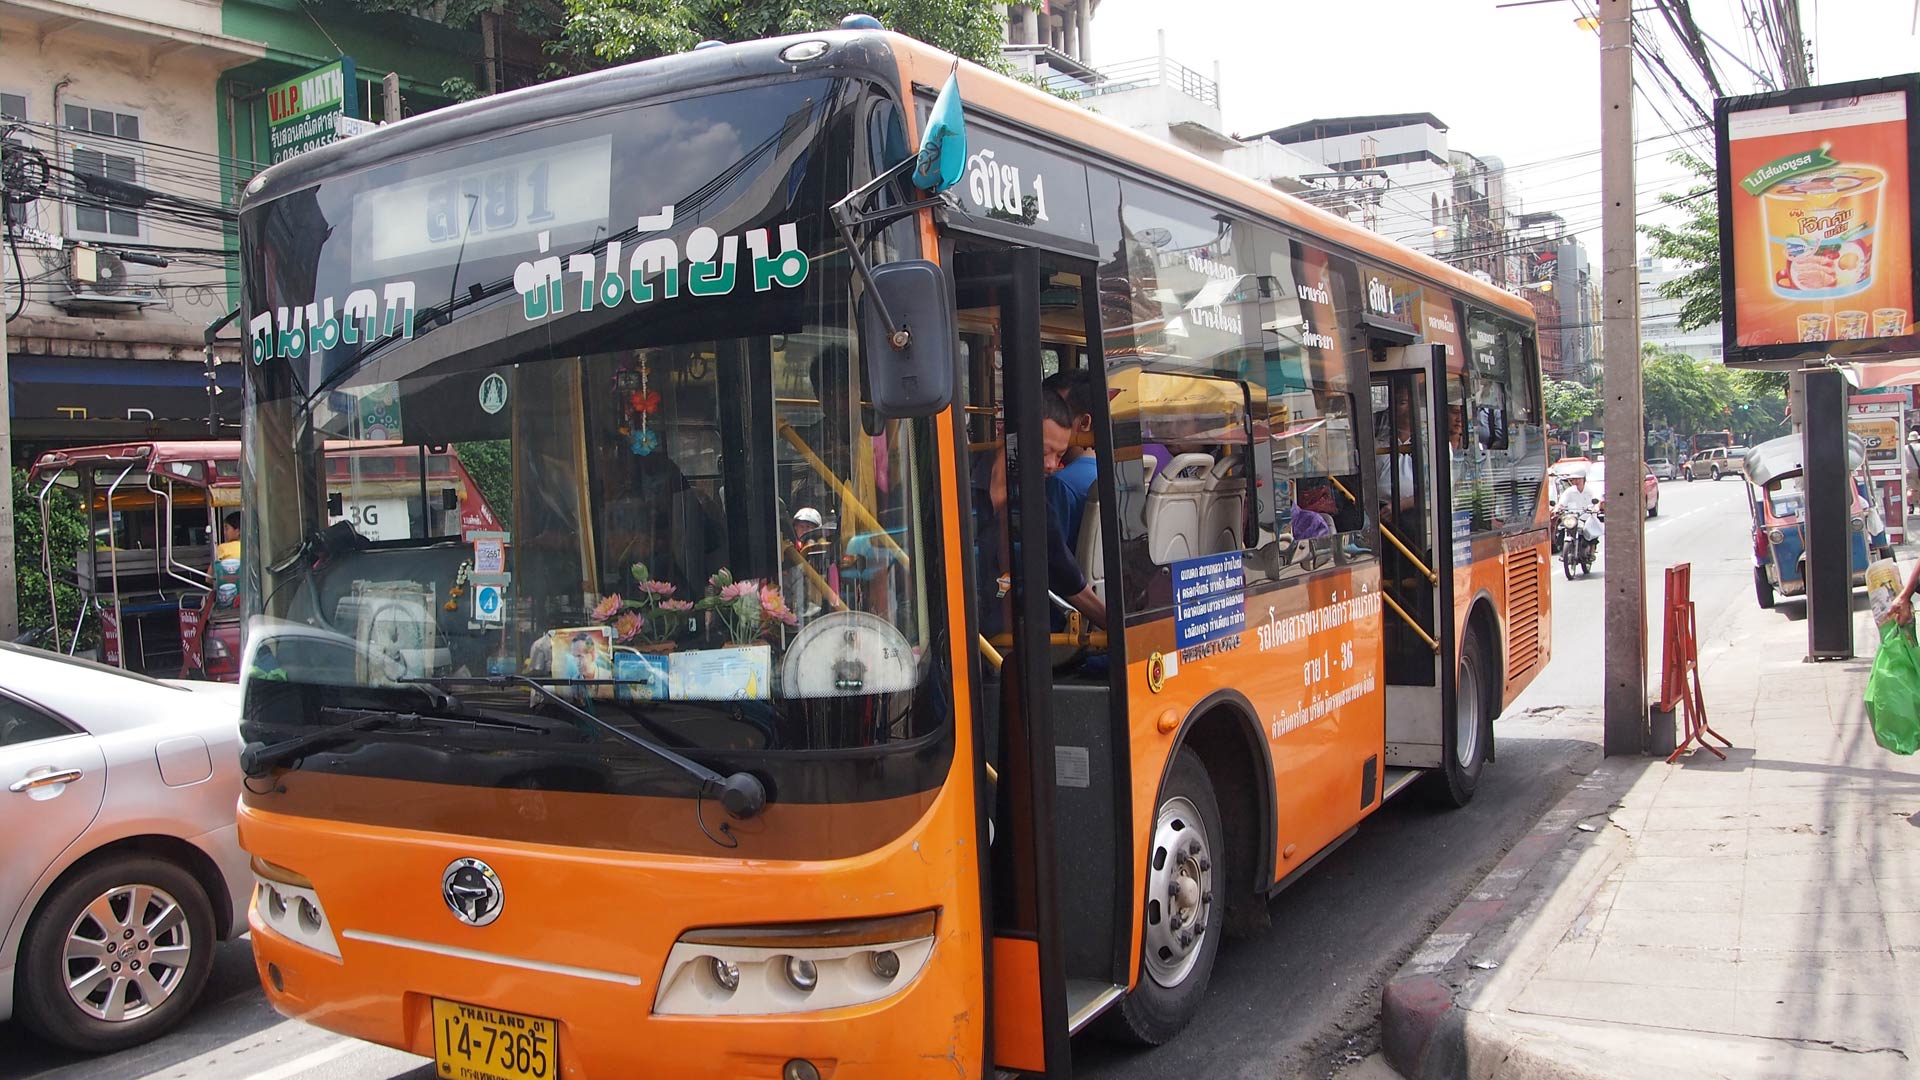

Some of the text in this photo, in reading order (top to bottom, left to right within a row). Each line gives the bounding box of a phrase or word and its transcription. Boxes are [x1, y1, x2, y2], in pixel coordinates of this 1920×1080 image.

[269, 68, 341, 122] V.I.P. MATH
[427, 160, 555, 243] สาย 1
[968, 148, 1049, 222] สาย 1
[514, 206, 810, 322] ท่าเตียน
[1190, 302, 1242, 336] บานใหม่
[1298, 282, 1328, 305] บางรัก
[1369, 276, 1395, 315] สาย 1
[249, 280, 416, 366] ถนนตก
[1303, 319, 1333, 350] สี่พระยา
[350, 504, 379, 526] 3G
[1257, 583, 1382, 652] รถโดยสารขนาดเล็กร่วมบริการ
[1304, 656, 1321, 687] สาย
[1324, 648, 1330, 679] 1
[1341, 639, 1353, 671] 36
[459, 1006, 545, 1034] THAILAND 01
[445, 1018, 548, 1078] 14-7365
